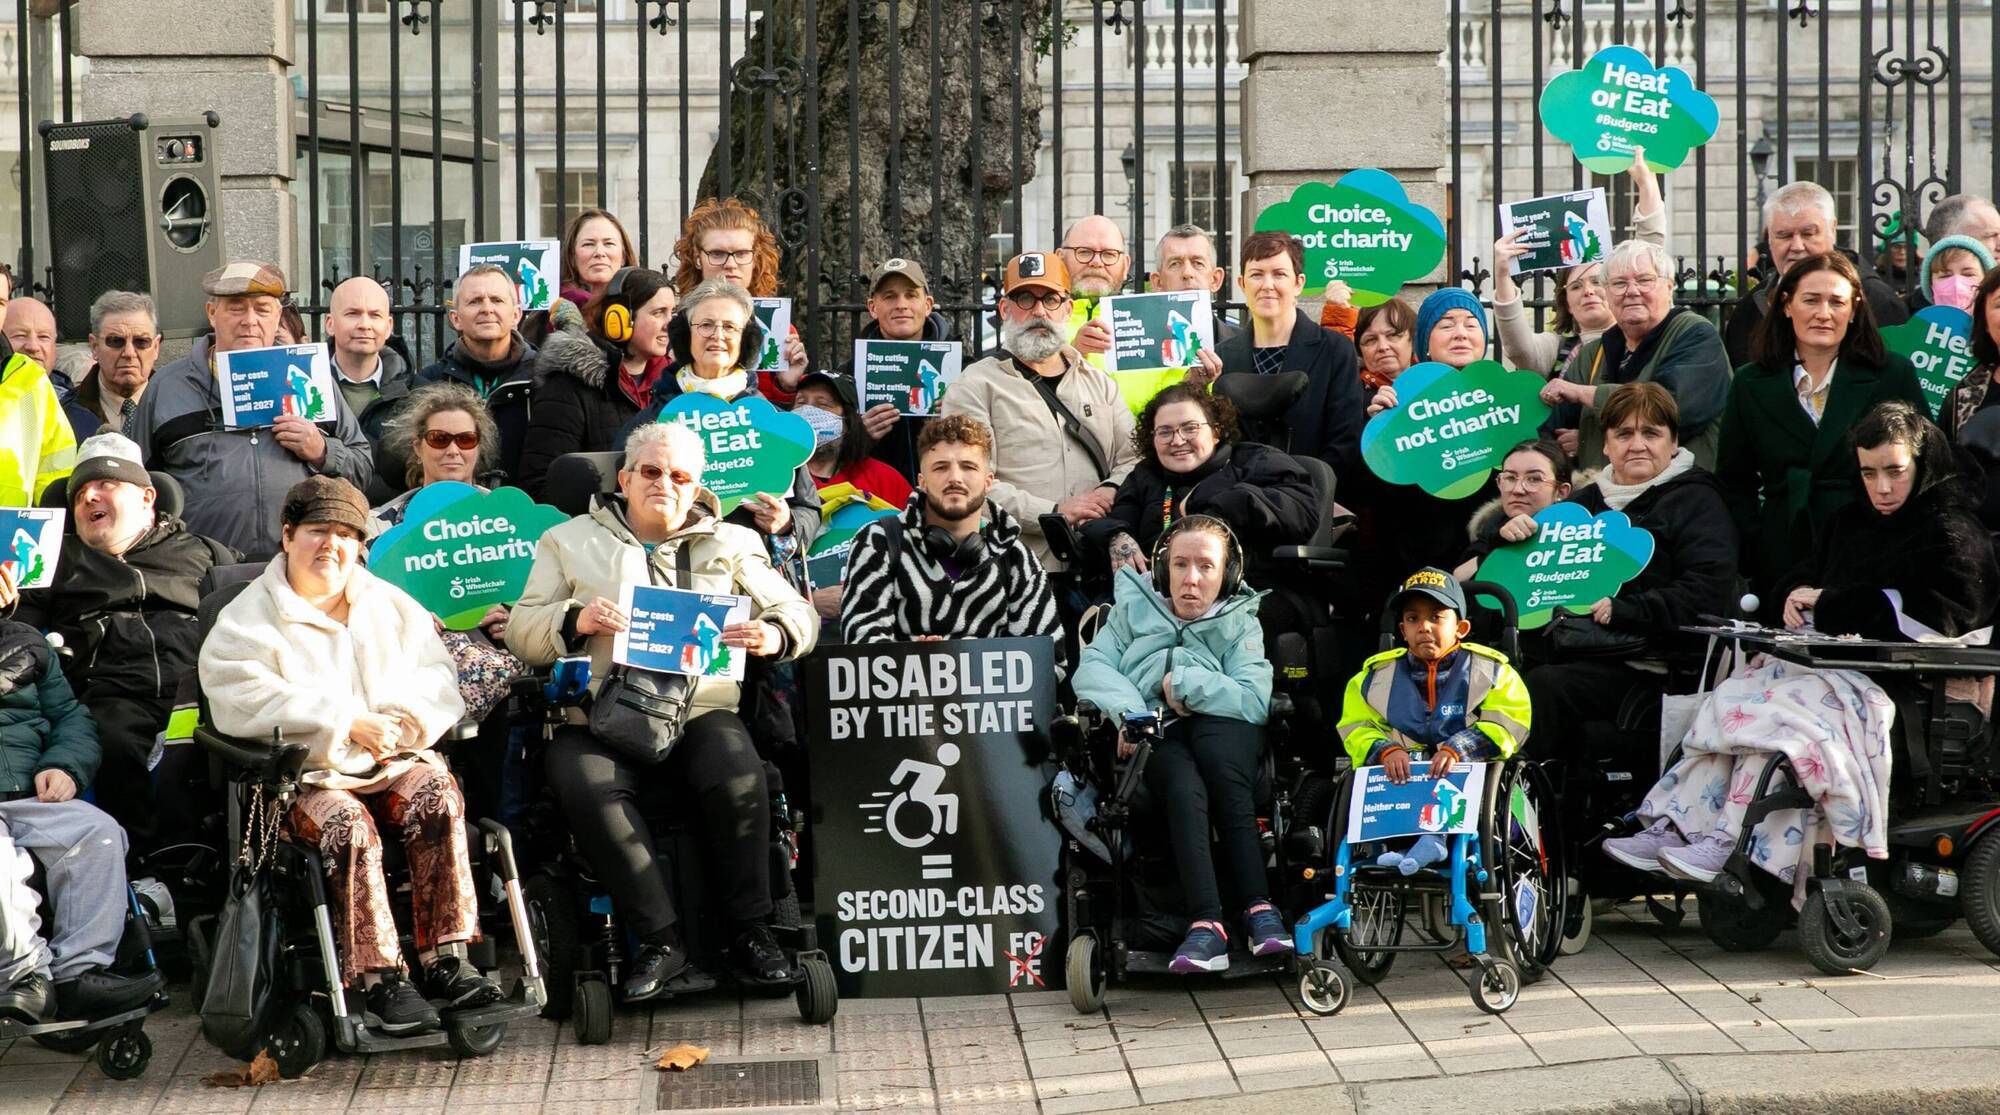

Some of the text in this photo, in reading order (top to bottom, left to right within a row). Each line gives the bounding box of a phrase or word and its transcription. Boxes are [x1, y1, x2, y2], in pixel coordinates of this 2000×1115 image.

[1602, 62, 1671, 94] Heat
[1591, 89, 1672, 119] or Eat
[1595, 114, 1658, 134] #Budget26
[1308, 203, 1392, 226] Choice,
[1512, 211, 1550, 224] Next year's
[1331, 228, 1413, 252] charity
[471, 254, 510, 264] Stop cutting
[1113, 310, 1131, 320] Stop
[1114, 318, 1142, 329] pushing
[1115, 328, 1145, 337] disabled
[1116, 337, 1155, 349] people into
[1925, 322, 1974, 357] He
[867, 353, 909, 364] Stop cutting
[1117, 348, 1146, 360] poverty
[1910, 350, 1943, 372] or
[867, 364, 902, 373] payments.
[232, 370, 269, 381] Our costs
[233, 381, 255, 392] won't
[866, 382, 911, 393] Start cutting
[234, 392, 251, 402] wait
[866, 393, 896, 402] poverty.
[235, 400, 274, 412] until 2027
[1408, 388, 1495, 421] Choice,
[678, 405, 752, 432] Heat
[1395, 404, 1520, 452] not charity
[710, 428, 762, 454] Eat
[1454, 447, 1470, 455] Irish
[1455, 447, 1492, 461] Wheelchair
[703, 457, 754, 472] udget26
[710, 482, 749, 491] Wheelchair
[423, 514, 516, 541] Choice,
[1539, 519, 1606, 543] Heat
[404, 537, 540, 572] not charity
[1526, 542, 1606, 567] or Eat
[465, 576, 481, 584] Irish
[1528, 570, 1590, 583] #Budget26
[465, 580, 506, 590] Wheelchair
[632, 607, 674, 621] Our costs
[631, 620, 656, 631] won't
[629, 631, 649, 641] wait
[628, 641, 674, 654] until 2027
[828, 650, 1034, 701] DISABLED
[1441, 704, 1464, 716] GARDA
[830, 700, 1034, 740] BY THE STATE
[1368, 774, 1392, 784] Winte
[1366, 784, 1386, 793] wait.
[1364, 802, 1411, 813] Neither can
[1363, 816, 1377, 824] we.
[837, 884, 1045, 922] SECOND-CLASS
[839, 923, 994, 973] CITIZEN
[1009, 931, 1043, 957] FG
[1009, 959, 1041, 987] FF
